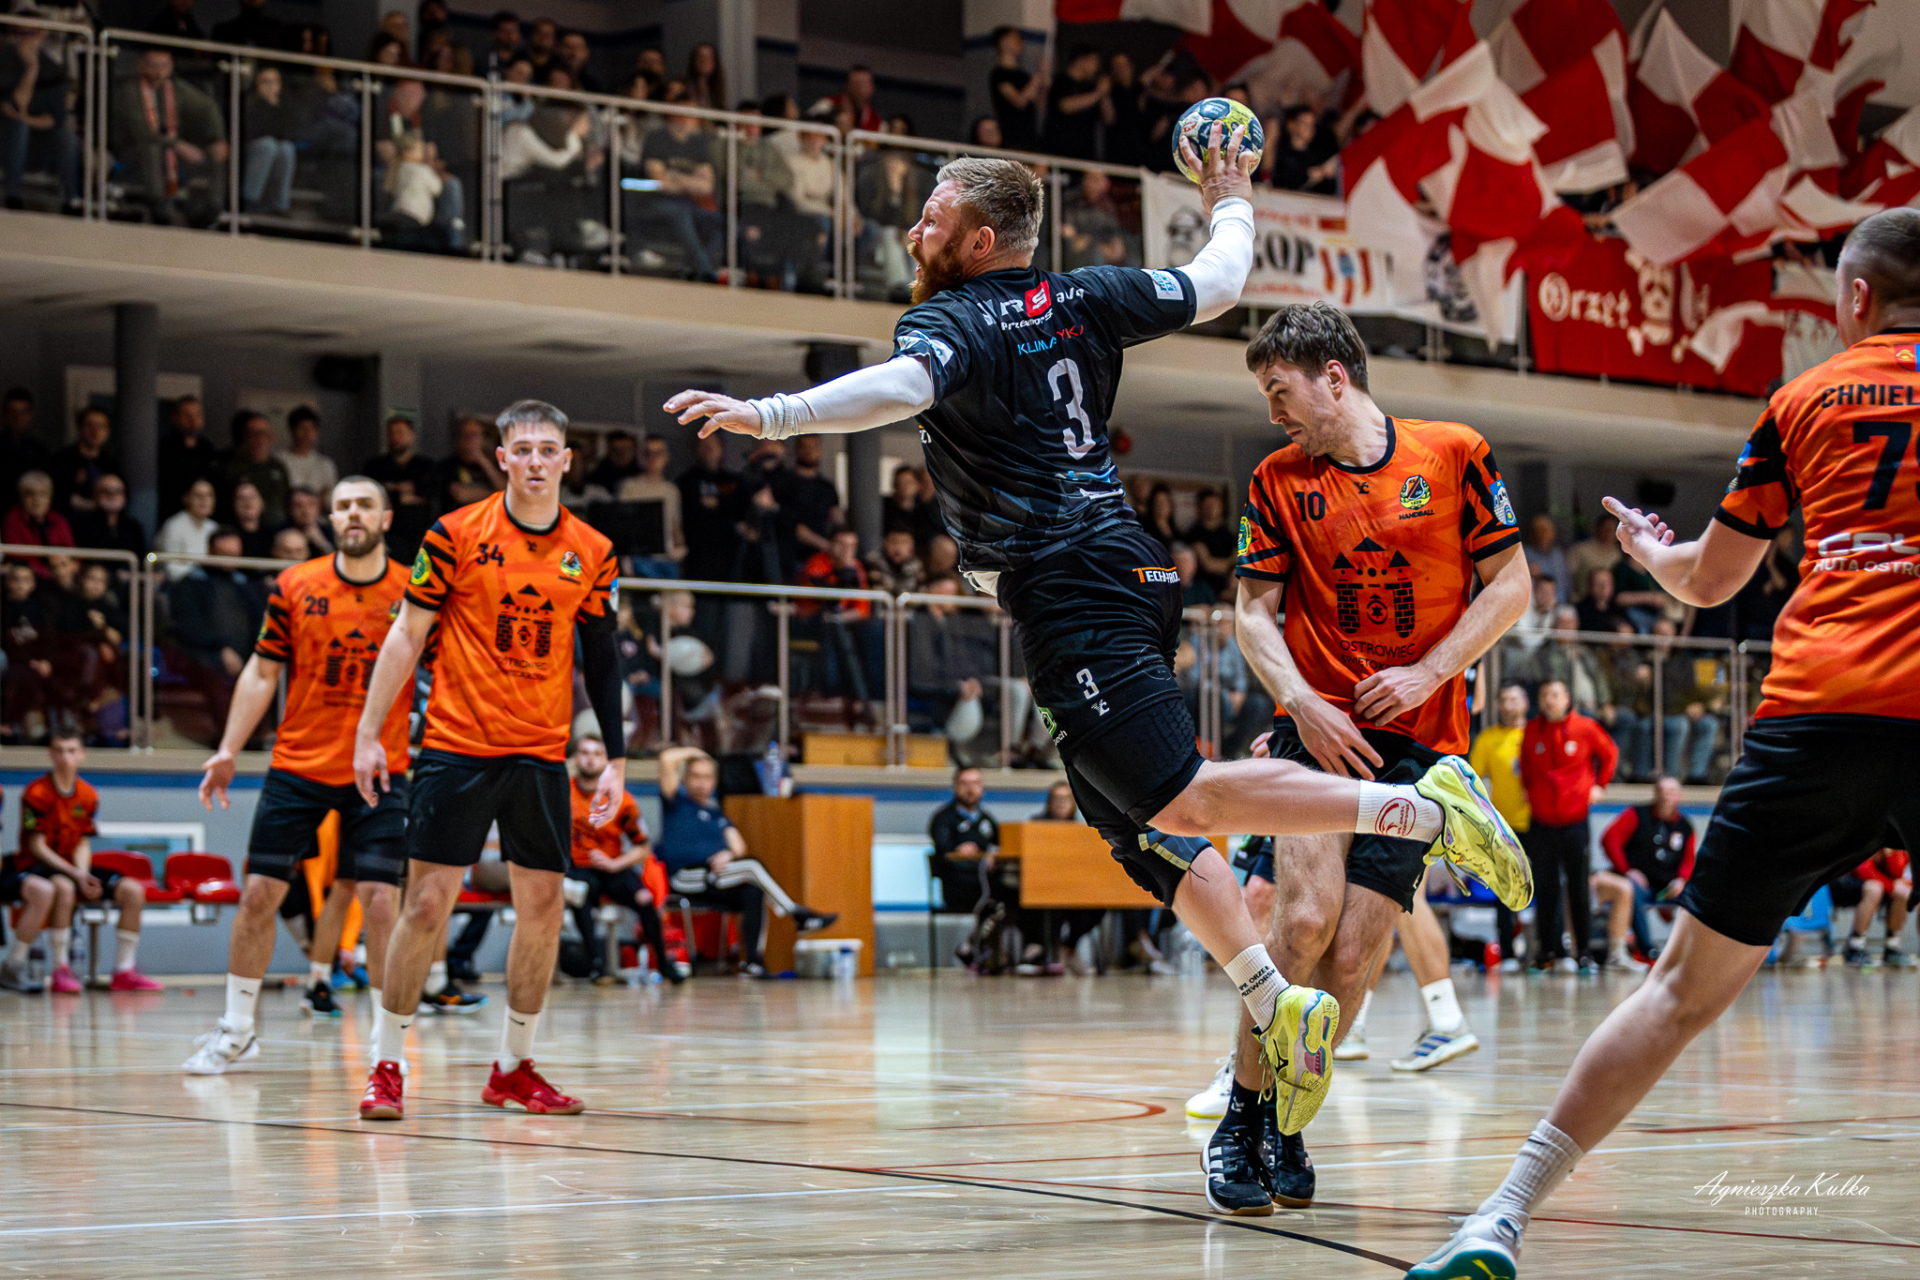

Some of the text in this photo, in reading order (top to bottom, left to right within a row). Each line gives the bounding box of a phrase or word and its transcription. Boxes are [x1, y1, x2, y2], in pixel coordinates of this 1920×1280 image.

[1047, 357, 1096, 460] 3
[1852, 421, 1920, 510] 7
[1295, 490, 1326, 522] 10
[1398, 508, 1435, 520] HANDBALL
[475, 542, 505, 567] 34
[1814, 558, 1859, 573] HUTA
[304, 595, 329, 616] 29
[1340, 640, 1416, 659] OSTROWIEC
[1076, 668, 1100, 700] 3
